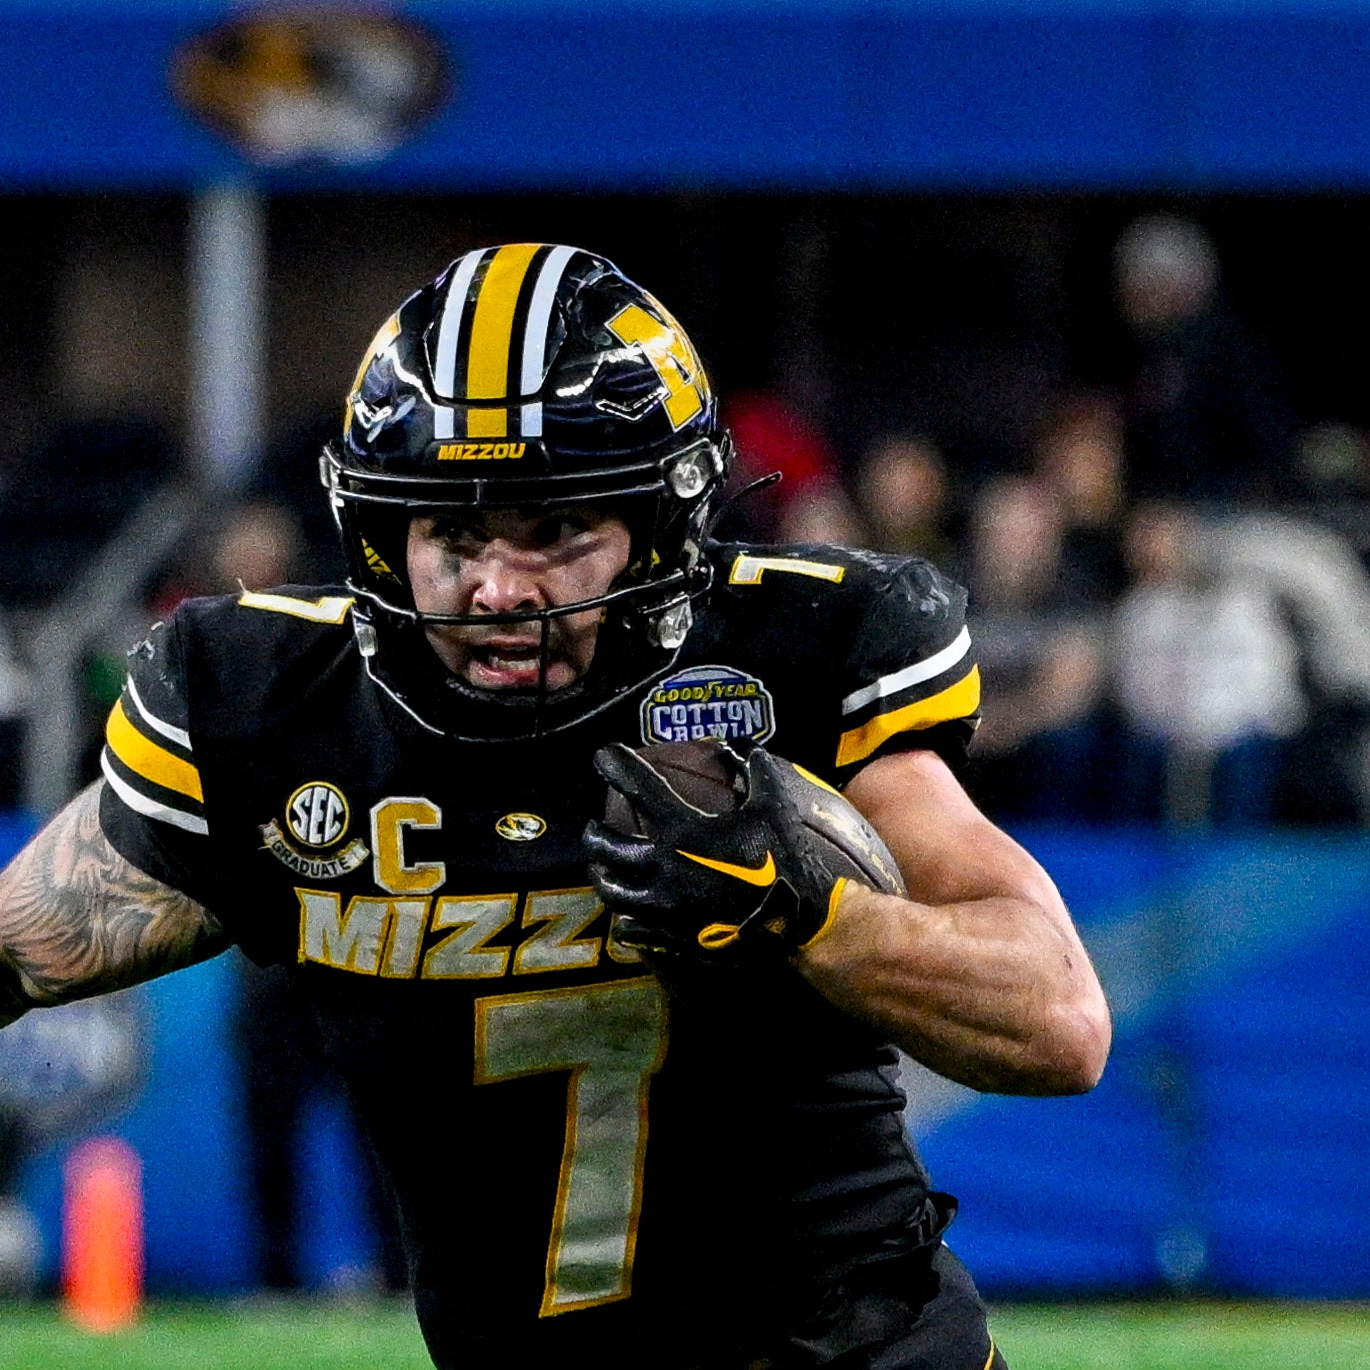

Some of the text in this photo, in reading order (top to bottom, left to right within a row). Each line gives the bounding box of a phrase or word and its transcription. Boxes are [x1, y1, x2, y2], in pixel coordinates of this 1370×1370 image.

[437, 442, 526, 460] MIZZOU
[654, 681, 758, 703] GOODYEAR
[652, 700, 763, 741] COTTON
[291, 786, 344, 844] SEC
[272, 840, 352, 877] GRADUATE
[369, 796, 447, 895] C
[294, 886, 645, 980] MIZZ
[473, 974, 671, 1318] 7
